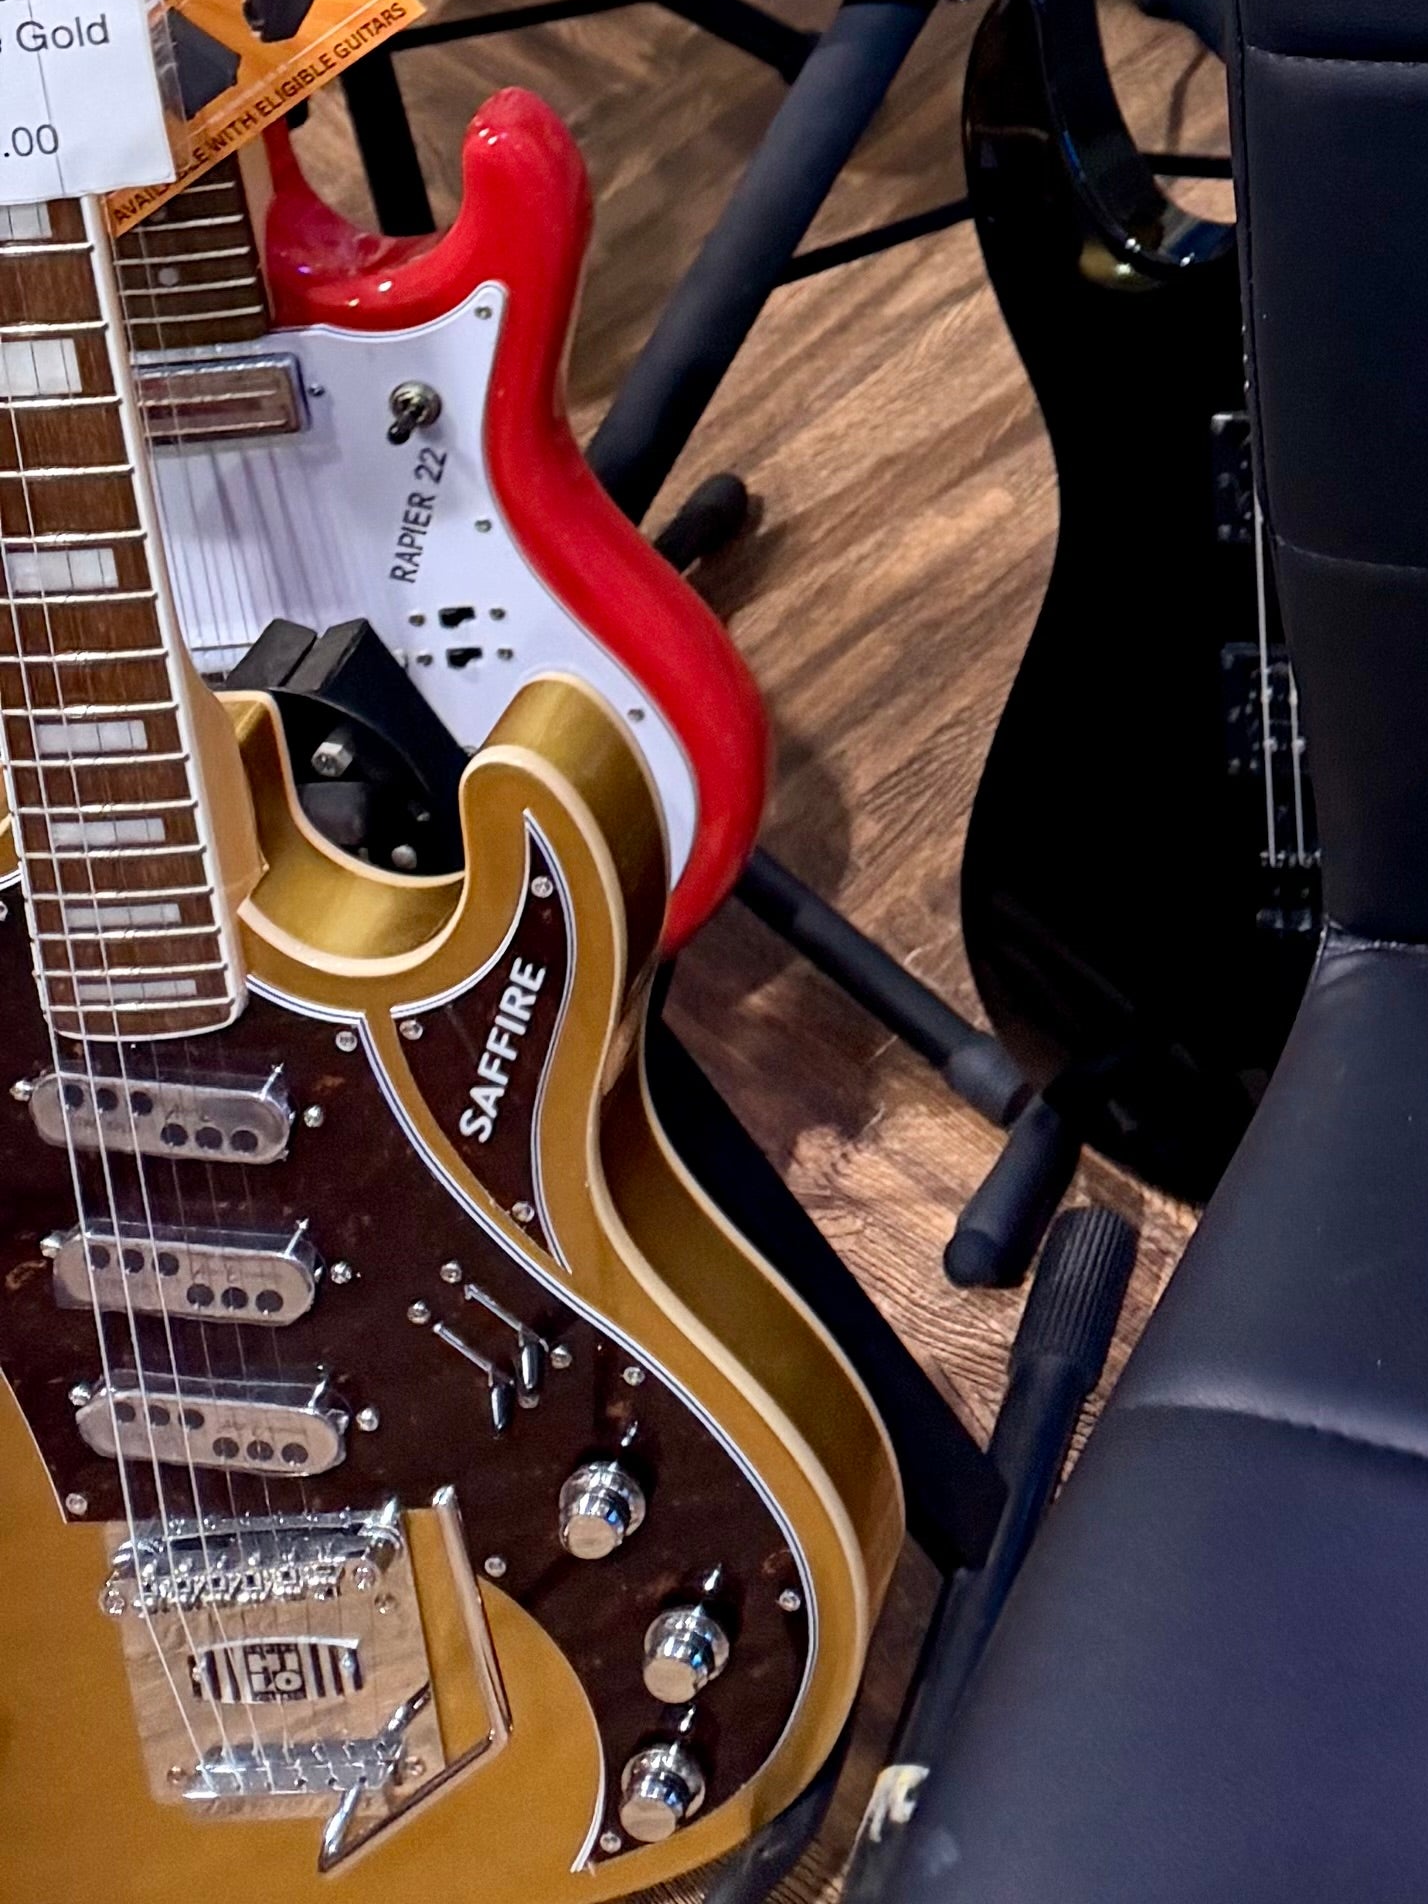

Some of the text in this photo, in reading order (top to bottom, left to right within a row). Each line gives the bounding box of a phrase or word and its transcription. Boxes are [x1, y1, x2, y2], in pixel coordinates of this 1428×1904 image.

[16, 13, 111, 52] Gold
[208, 112, 261, 154] WITH
[255, 54, 337, 118] ELIGIBLE
[333, 1, 408, 60] GUITARS
[389, 447, 448, 583] RAPIER 22
[459, 956, 547, 1146] SAFFIRE
